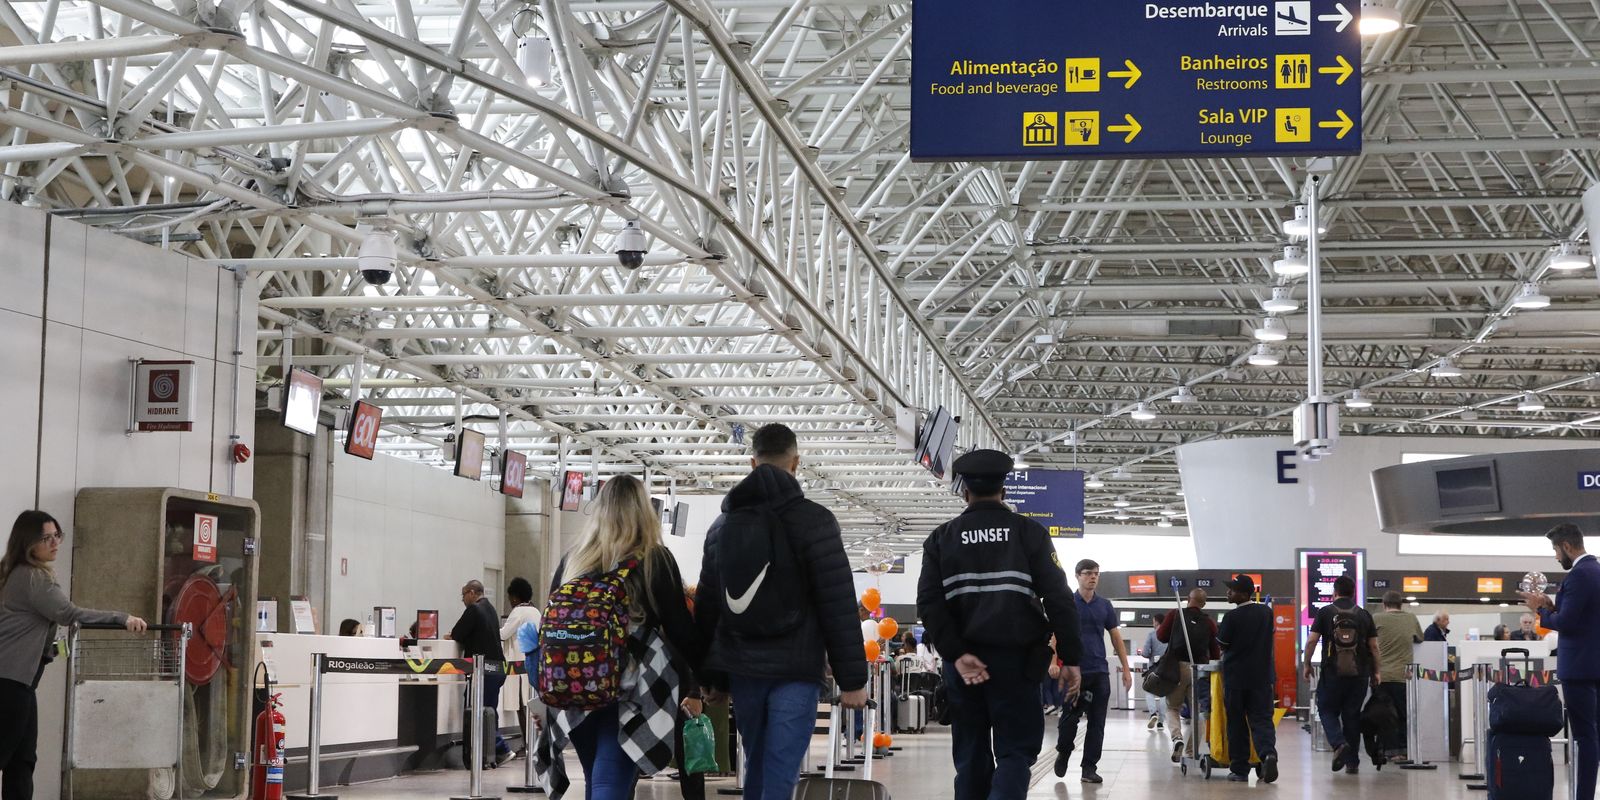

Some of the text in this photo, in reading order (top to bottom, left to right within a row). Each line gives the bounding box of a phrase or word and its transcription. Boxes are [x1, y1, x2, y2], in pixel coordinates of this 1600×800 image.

[1145, 2, 1268, 20] Desembarque
[1217, 23, 1268, 37] Arrivals
[950, 59, 1058, 77] Alimentação
[1181, 55, 1268, 71] Banheiros
[931, 80, 1058, 96] Food and beverage
[1197, 77, 1268, 90] Restrooms
[1199, 108, 1268, 124] Sala VIP
[1201, 132, 1252, 147] Lounge
[147, 407, 179, 415] HIDRANTE
[354, 413, 378, 449] GOL
[505, 459, 524, 490] GOL
[1276, 450, 1298, 484] E
[961, 527, 1010, 545] SUNSET
[327, 660, 375, 671] RIOgaleão
